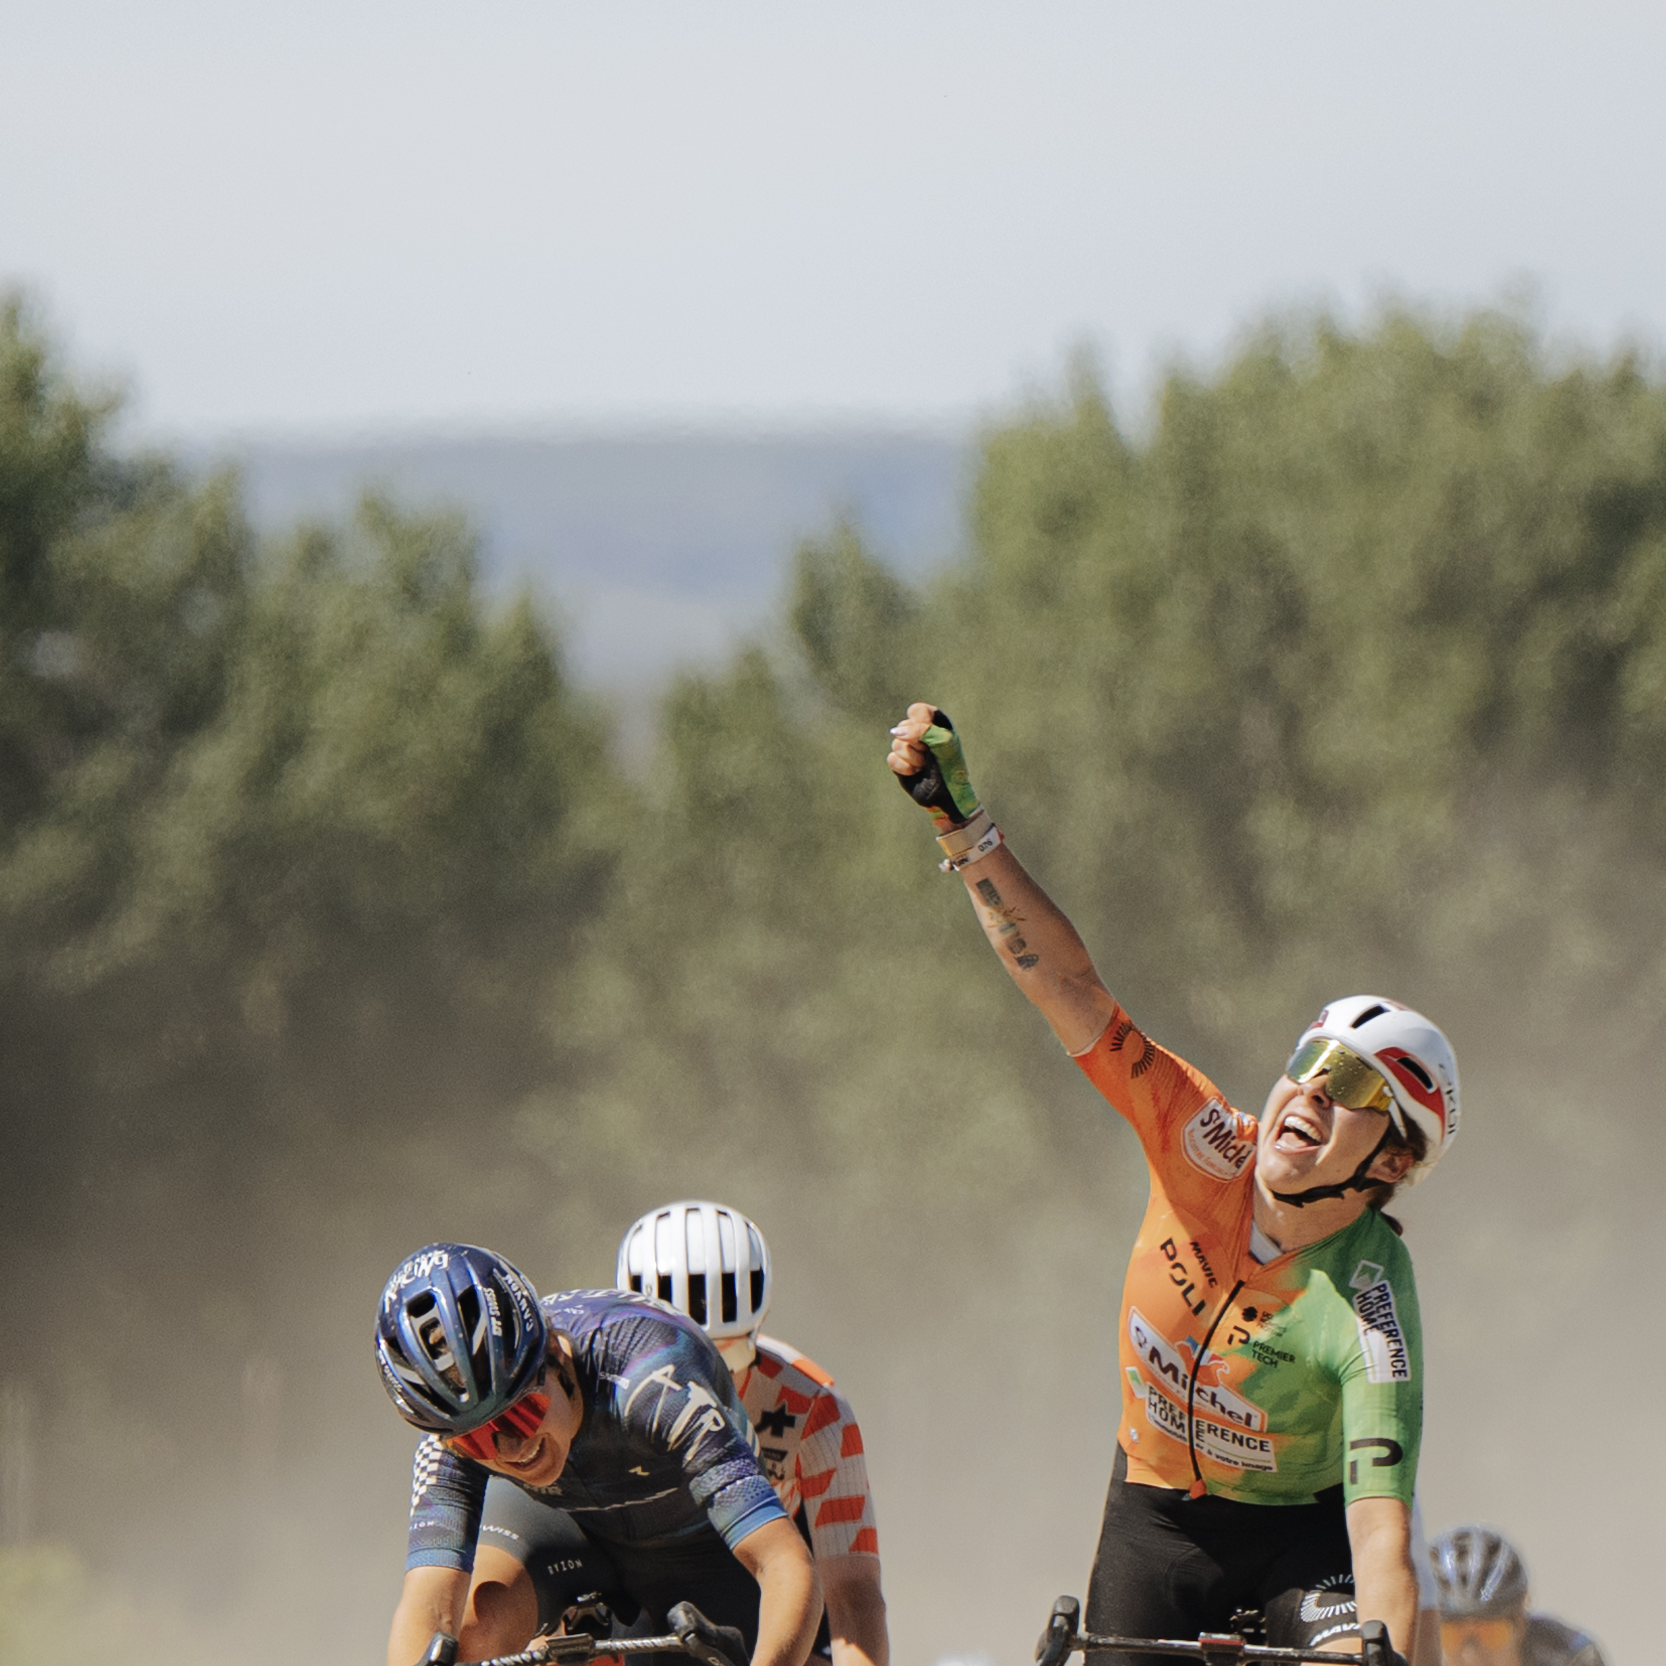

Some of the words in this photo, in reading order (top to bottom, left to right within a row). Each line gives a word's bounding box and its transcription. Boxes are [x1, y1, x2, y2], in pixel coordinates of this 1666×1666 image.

[1190, 1241, 1218, 1289] MAVIC
[1252, 1341, 1296, 1364] PREMIER
[1373, 1283, 1408, 1378] PREFERENCE
[1251, 1349, 1279, 1369] TECH
[1149, 1346, 1253, 1427] Michel
[1149, 1386, 1271, 1453] PREFERENCE
[480, 1524, 520, 1541] WISS
